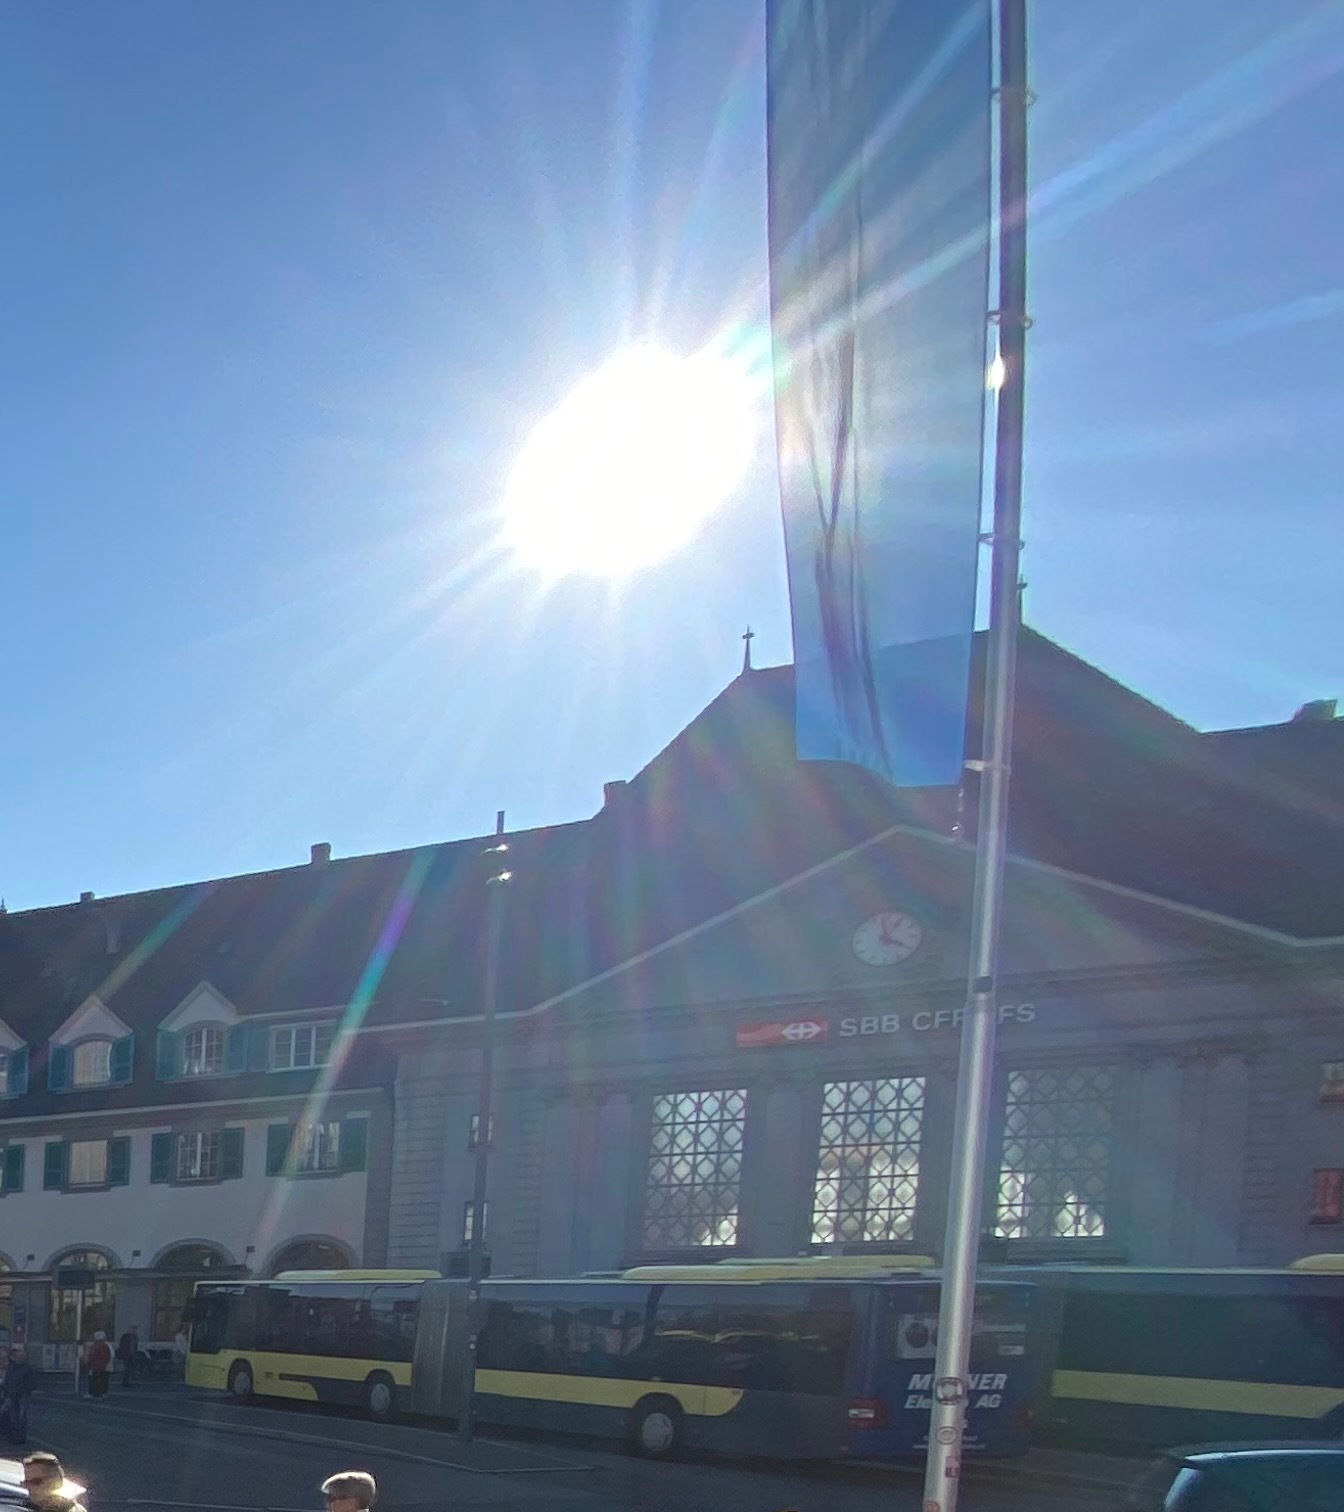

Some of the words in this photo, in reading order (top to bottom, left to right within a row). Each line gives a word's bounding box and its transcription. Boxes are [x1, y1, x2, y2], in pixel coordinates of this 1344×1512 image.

[839, 1014, 900, 1037] SBB
[996, 1003, 1037, 1024] FS
[974, 1394, 1002, 1408] AG
